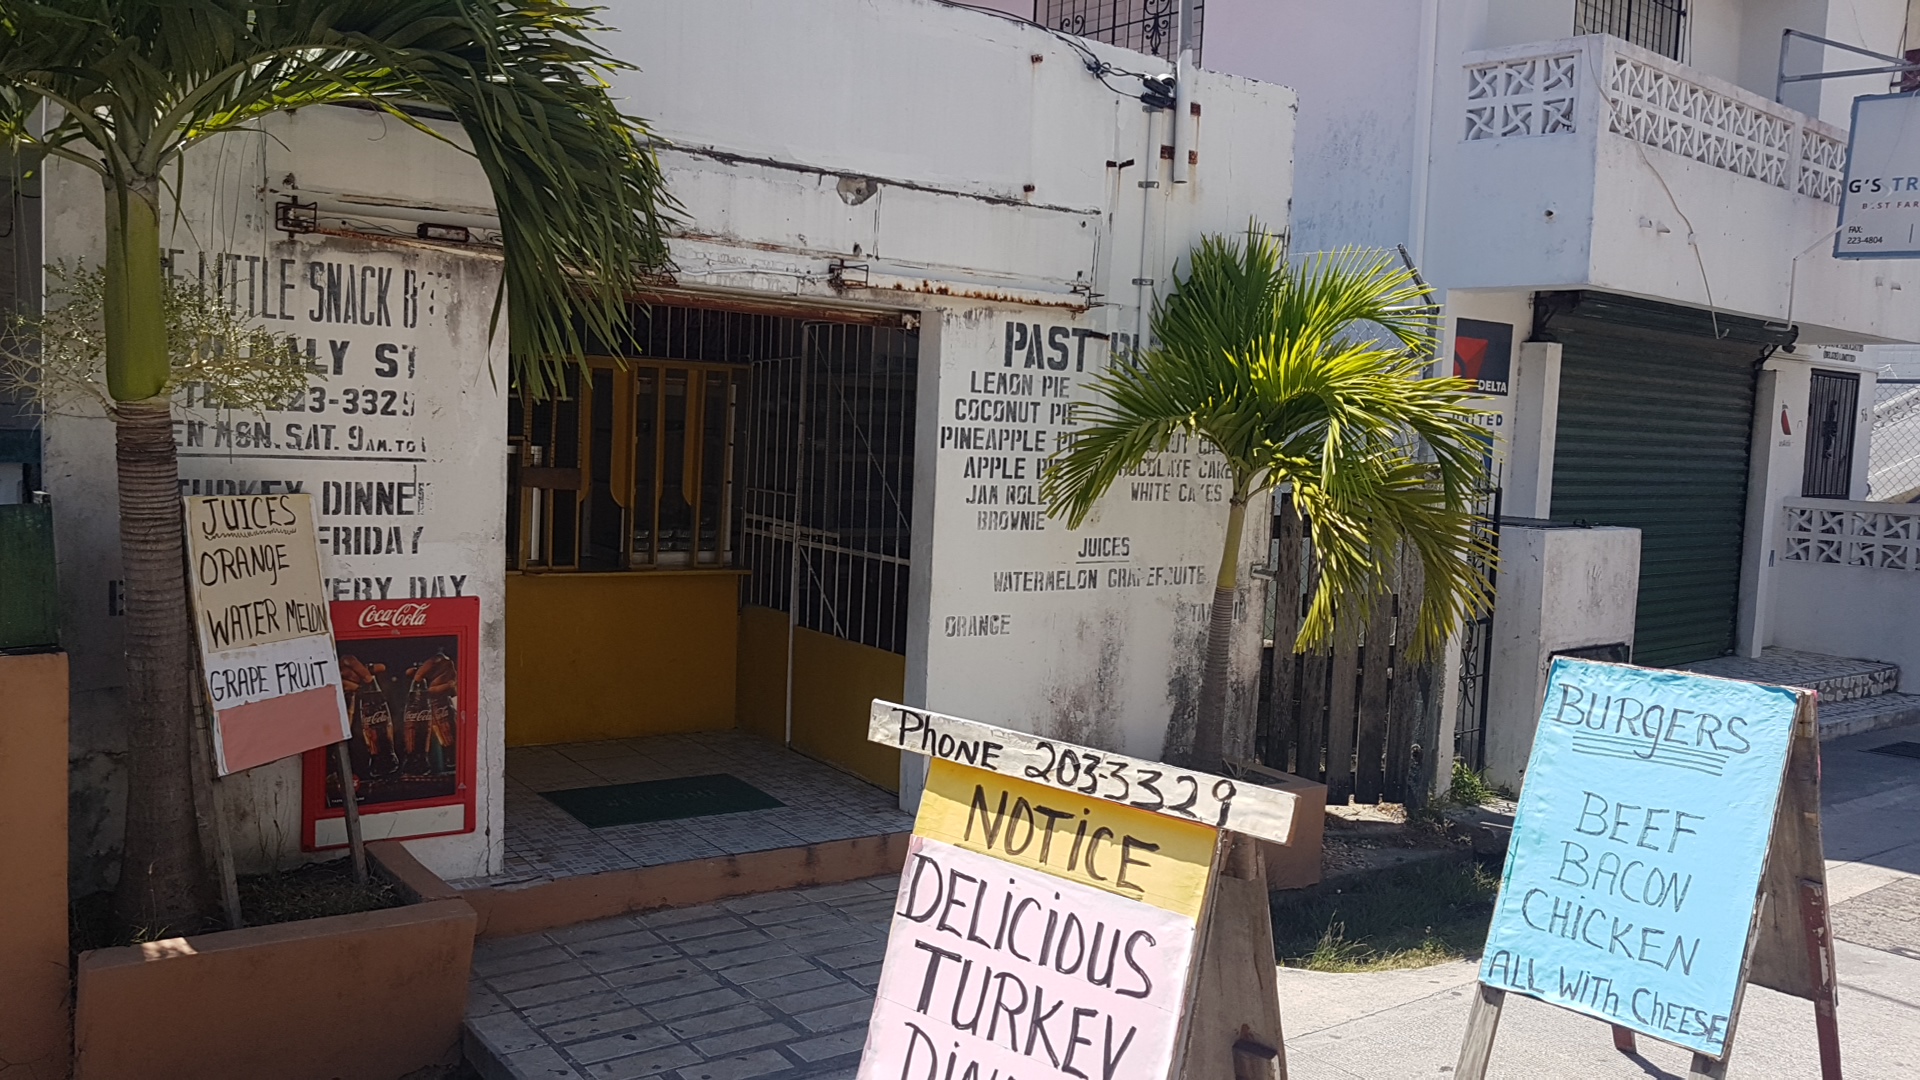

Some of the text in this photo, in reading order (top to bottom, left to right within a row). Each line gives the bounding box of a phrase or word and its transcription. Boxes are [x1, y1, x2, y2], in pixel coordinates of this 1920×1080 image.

[1848, 178, 1882, 194] G'S
[1847, 236, 1883, 245] 223-4804
[308, 261, 393, 328] SNACK
[970, 370, 1071, 399] LEMON PIE
[1478, 379, 1507, 393] DELTA
[955, 398, 1079, 426] COCONUT PIE
[940, 426, 1047, 452] PINEAPPLE
[963, 456, 1026, 480] APPLE
[966, 484, 998, 505] JAM
[1131, 482, 1223, 503] WHITE CAES
[202, 495, 296, 535] JUICES
[1077, 536, 1130, 558] JUICES
[993, 568, 1098, 593] WATERMELON
[206, 598, 281, 648] WATER
[944, 614, 1011, 638] ORANGE
[210, 666, 270, 702] GRAPE
[1573, 790, 1705, 853] BEEF
[1550, 840, 1692, 913] BACON
[1488, 950, 1545, 994] ALL
[915, 939, 1137, 1080] TURKEY
